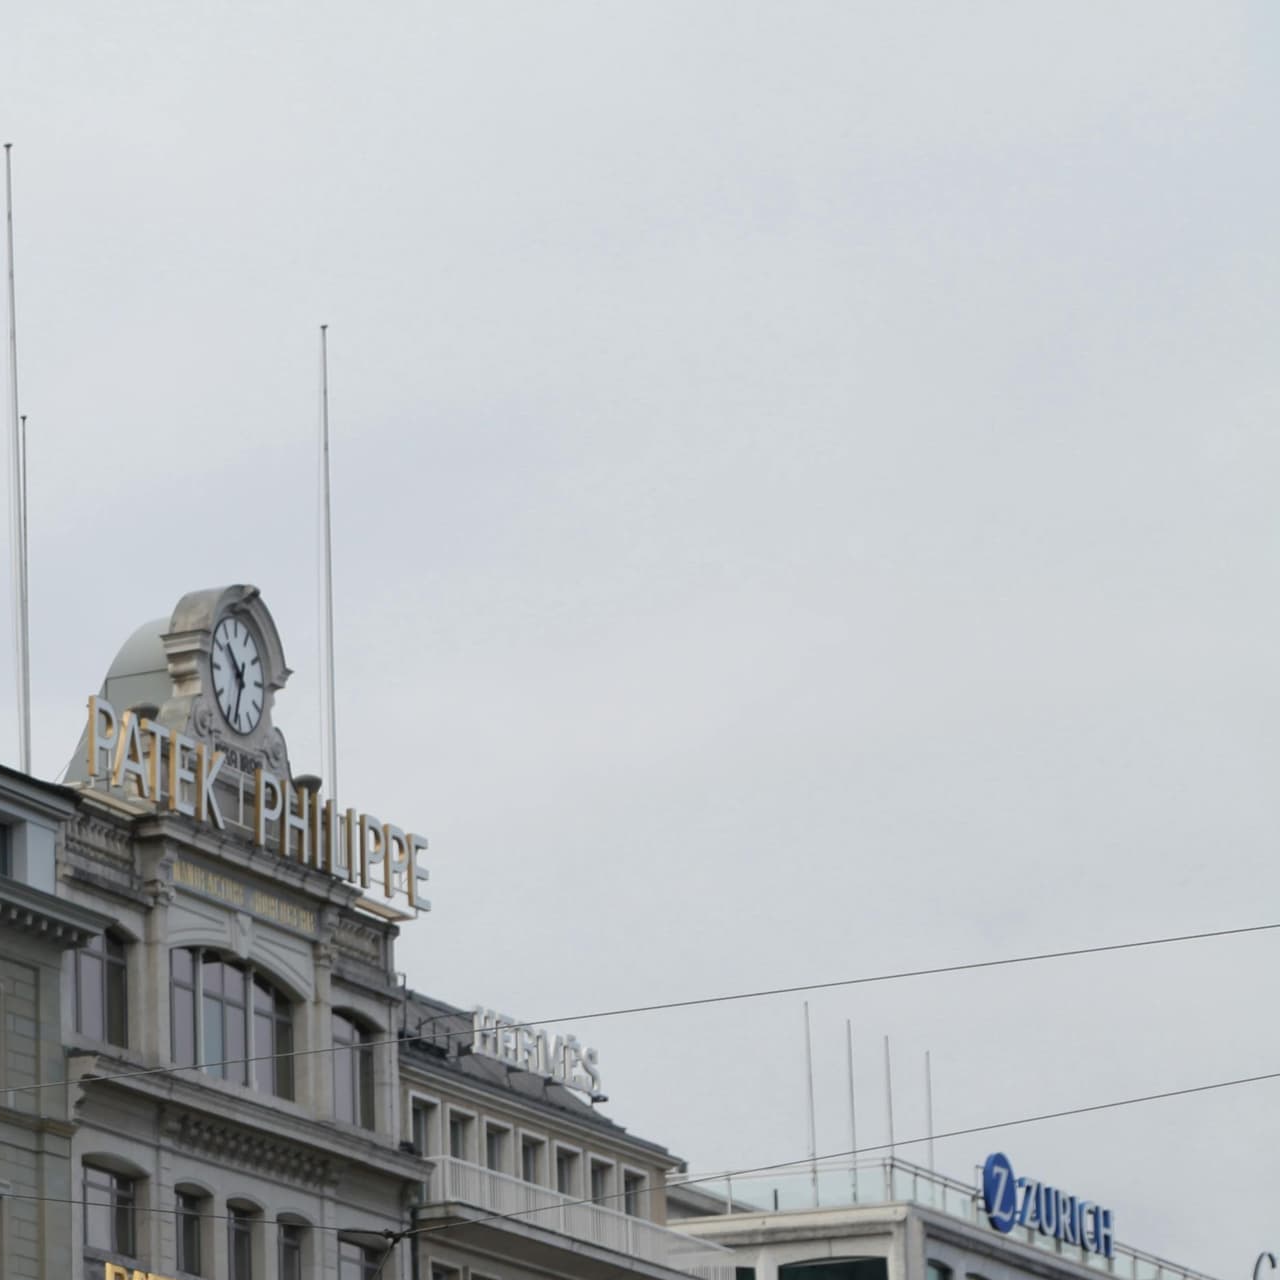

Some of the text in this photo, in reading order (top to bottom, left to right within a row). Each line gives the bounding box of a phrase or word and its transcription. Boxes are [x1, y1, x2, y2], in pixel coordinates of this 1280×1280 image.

[89, 695, 432, 912] PATEK PHILIPPE
[1017, 1176, 1116, 1259] ZURICH
